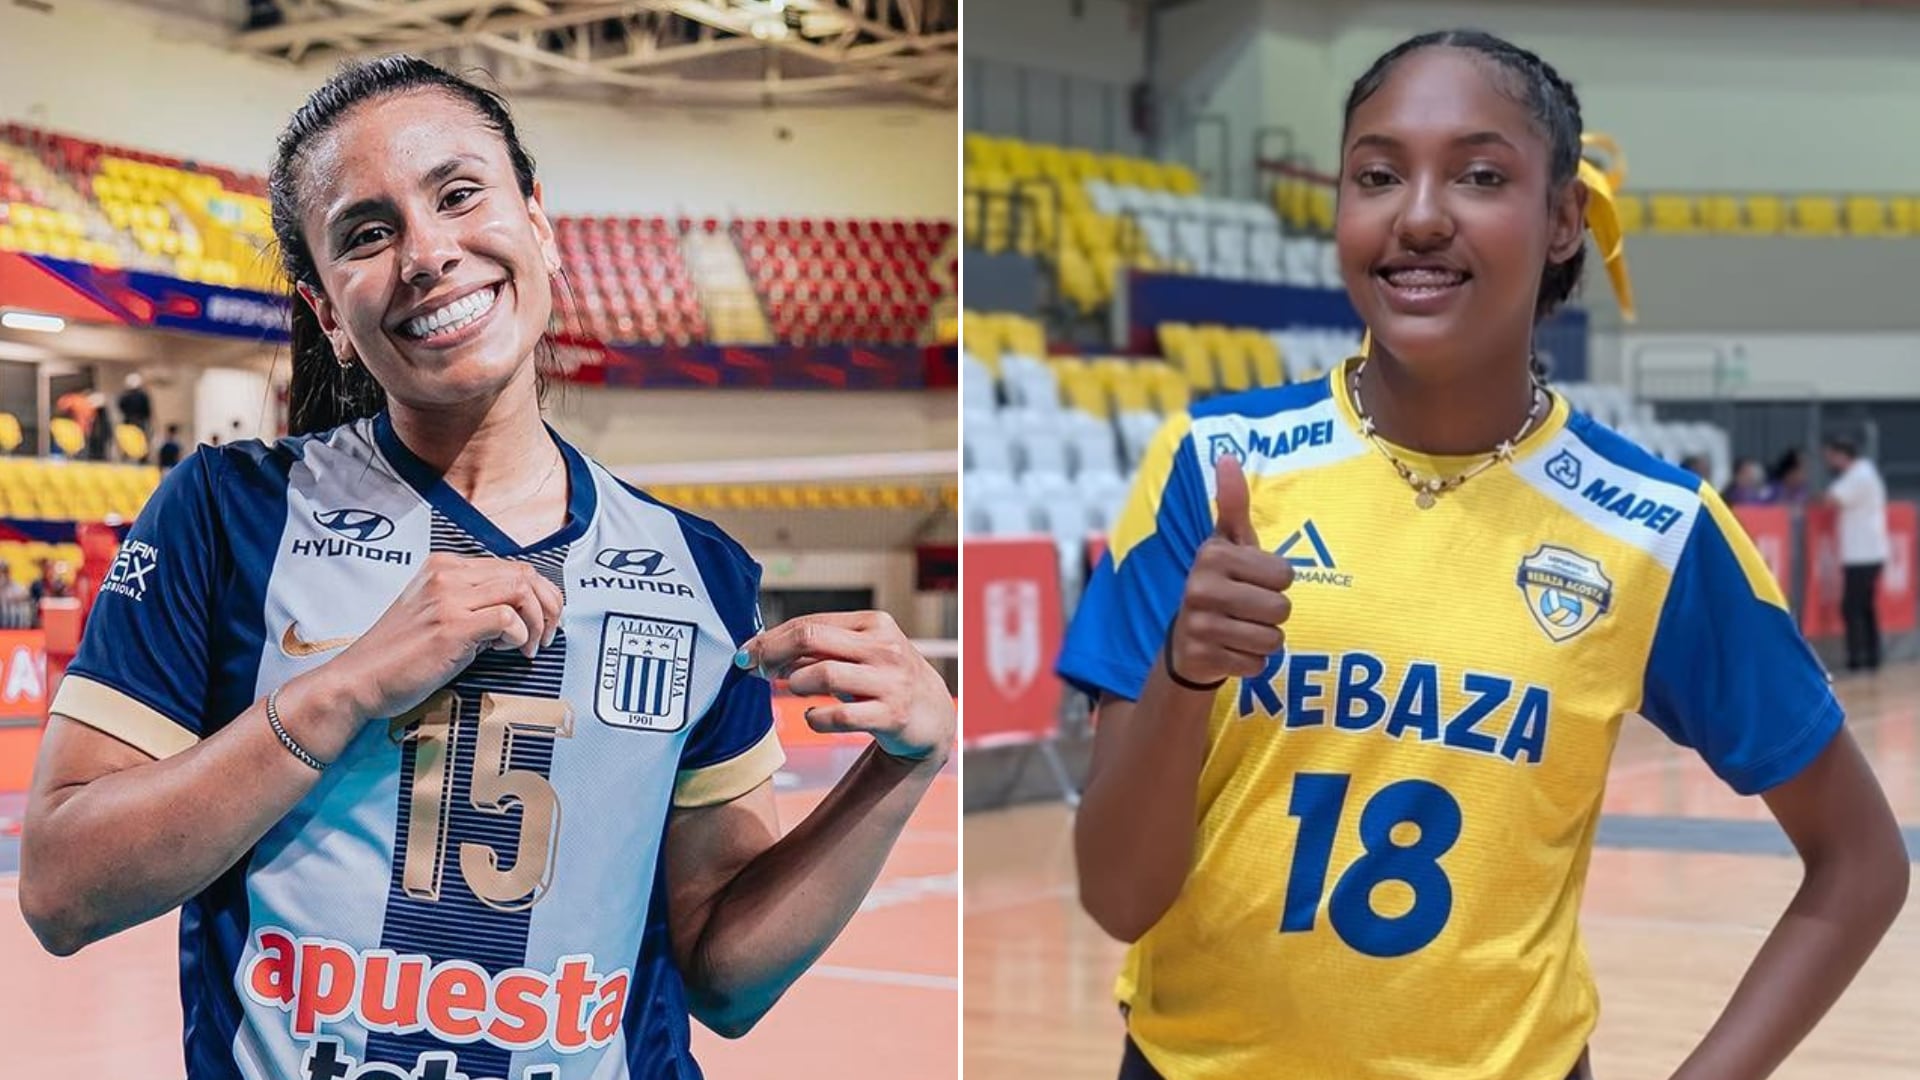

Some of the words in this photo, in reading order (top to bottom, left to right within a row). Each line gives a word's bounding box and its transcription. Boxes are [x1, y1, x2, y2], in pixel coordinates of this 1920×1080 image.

[1248, 417, 1334, 459] MAPEI
[1580, 477, 1683, 535] MAPEI
[291, 538, 412, 566] HYUNDAI
[616, 620, 685, 640] ALIANZA
[602, 646, 619, 691] CLUB
[672, 655, 689, 699] LIMA
[627, 713, 654, 727] 1901
[1237, 645, 1552, 764] REBAZA
[390, 690, 575, 911] 15
[1279, 771, 1464, 957] 18
[248, 931, 632, 1047] apuesta
